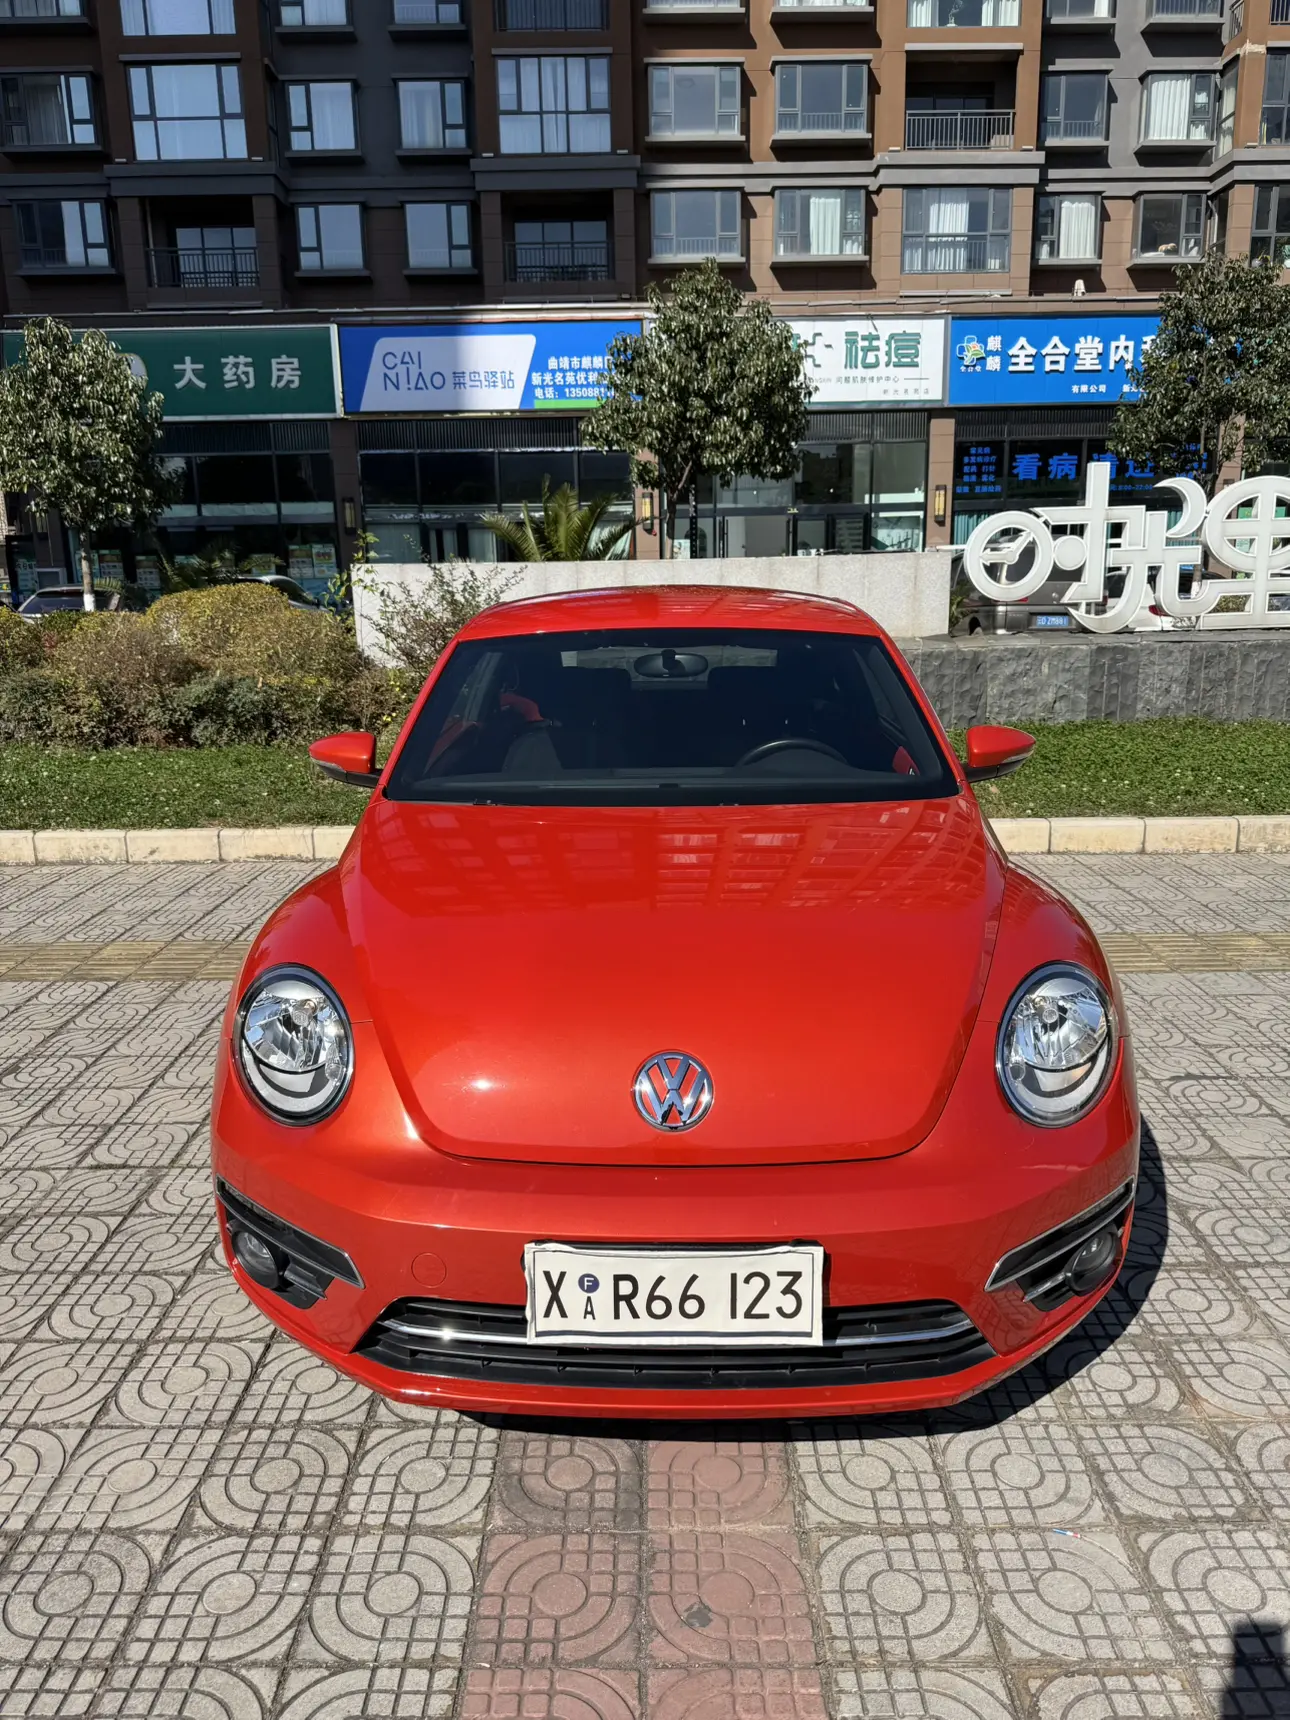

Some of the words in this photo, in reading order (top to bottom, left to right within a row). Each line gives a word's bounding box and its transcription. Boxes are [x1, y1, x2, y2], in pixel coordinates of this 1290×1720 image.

[382, 351, 422, 370] CAI
[173, 354, 302, 390] 大药房
[452, 370, 515, 390] 菜鸟驿站
[1071, 384, 1107, 394] 有限公司
[542, 1270, 568, 1319] X
[583, 1295, 596, 1320] A
[613, 1273, 706, 1320] R66
[729, 1271, 803, 1320] 123
